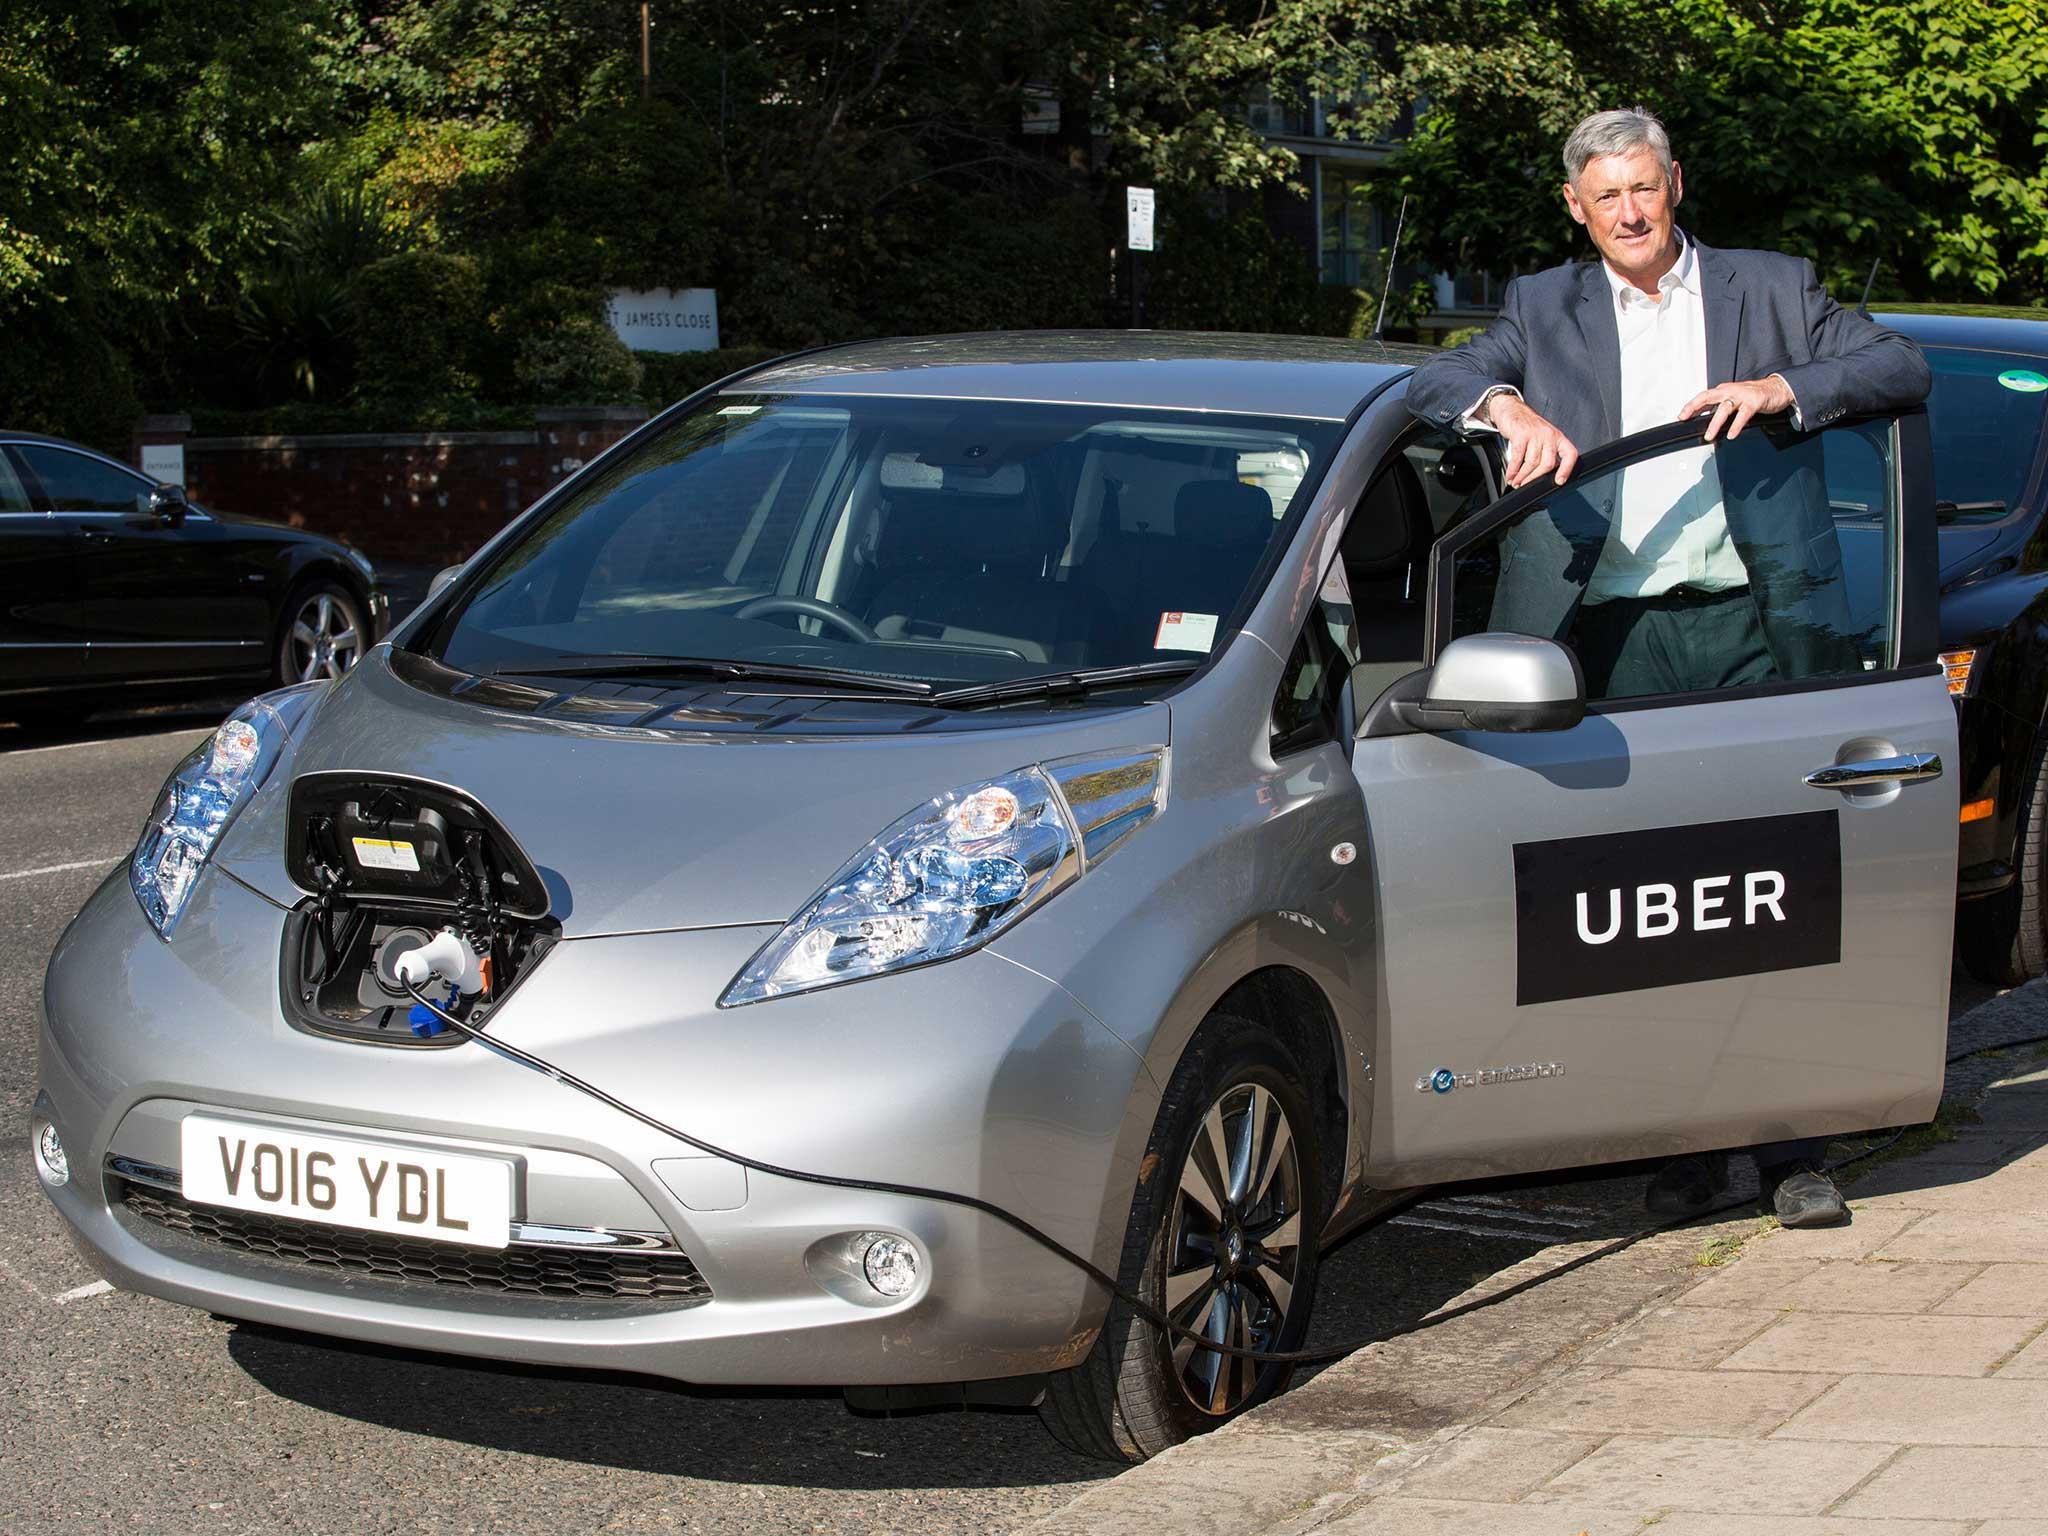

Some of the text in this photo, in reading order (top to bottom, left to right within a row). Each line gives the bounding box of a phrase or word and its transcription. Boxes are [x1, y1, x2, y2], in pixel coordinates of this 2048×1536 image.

[626, 311, 671, 327] JAMES'S
[674, 312, 711, 329] CLOSE
[1575, 870, 1787, 945] UBER
[218, 1136, 470, 1231] VO16 YDL
